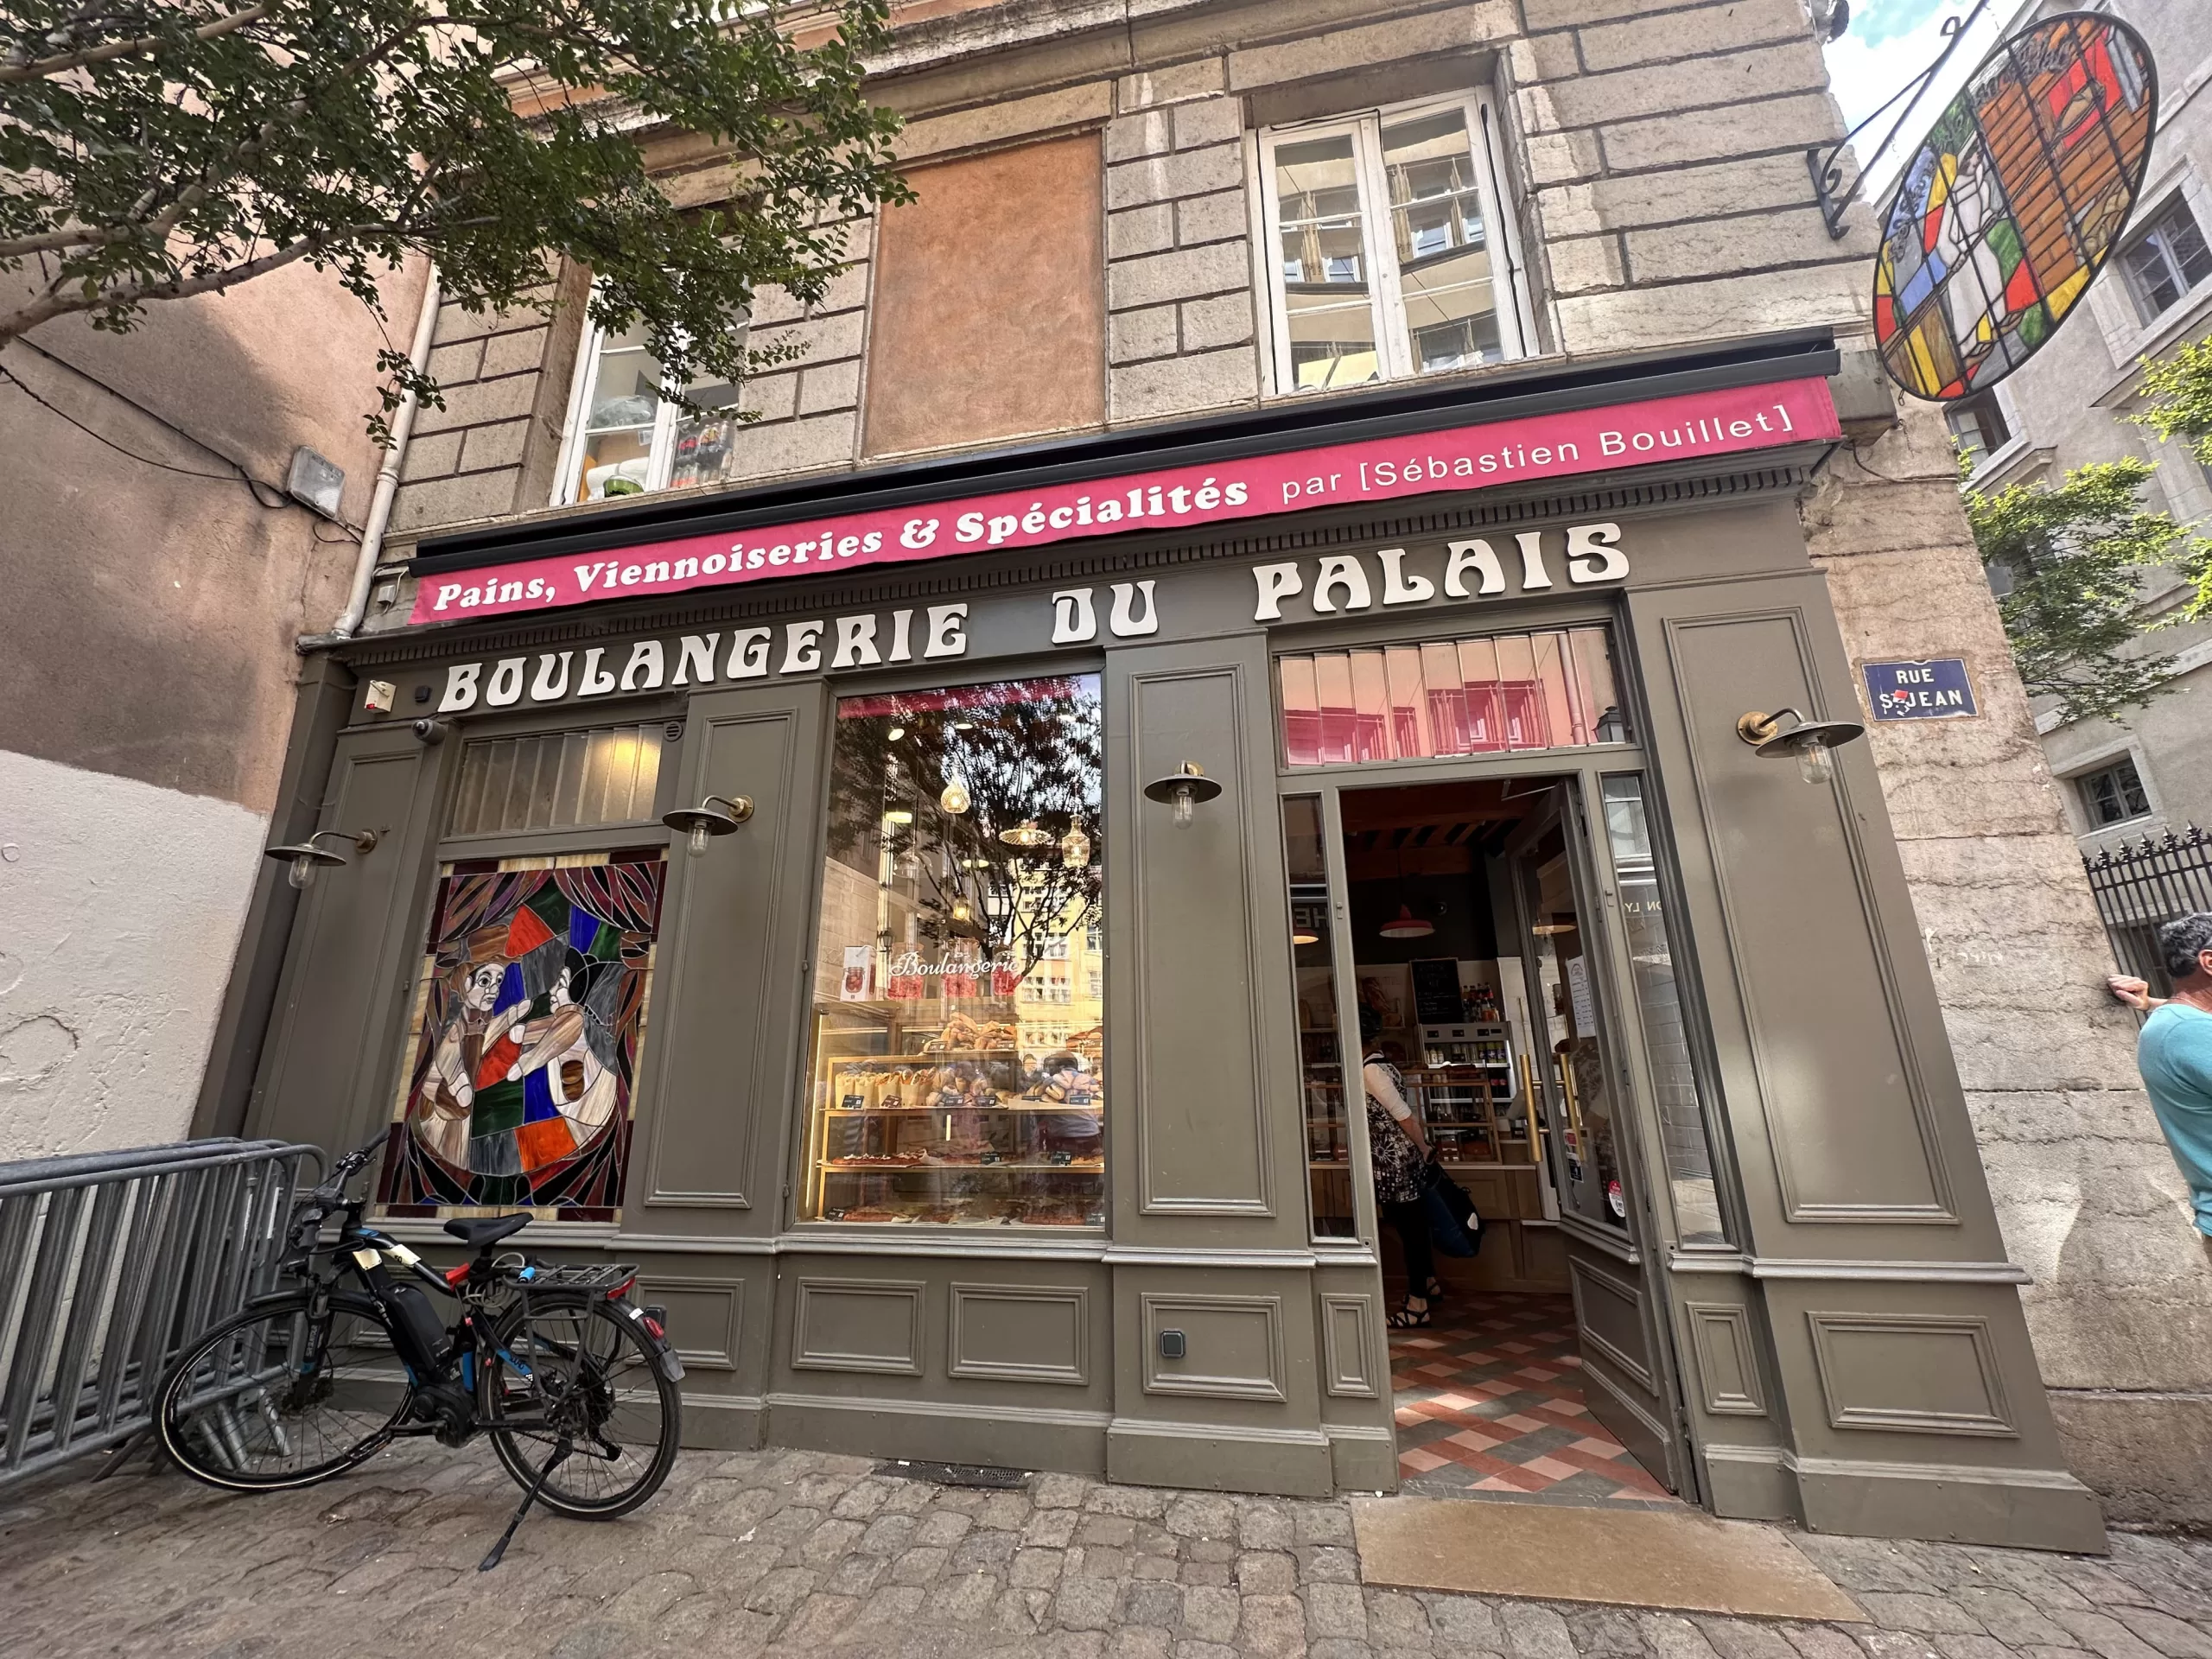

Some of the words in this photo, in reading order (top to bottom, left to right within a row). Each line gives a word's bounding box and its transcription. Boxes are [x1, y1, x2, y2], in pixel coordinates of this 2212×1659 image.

[433, 577, 556, 611] Pains,
[574, 531, 883, 593] Viennoiseries
[899, 518, 940, 550] &
[955, 477, 1249, 545] Spécialités
[1282, 472, 1343, 505] par
[1359, 442, 1580, 492] [Sébastien
[1599, 404, 1794, 457] Bouillet]
[437, 603, 969, 713] BOULANGERIE
[1051, 580, 1159, 644] DU
[1252, 522, 1630, 620] PALAIS
[1895, 668, 1935, 684] RUE
[1905, 690, 1963, 708] JEAN
[889, 950, 1019, 979] Boulangerie
